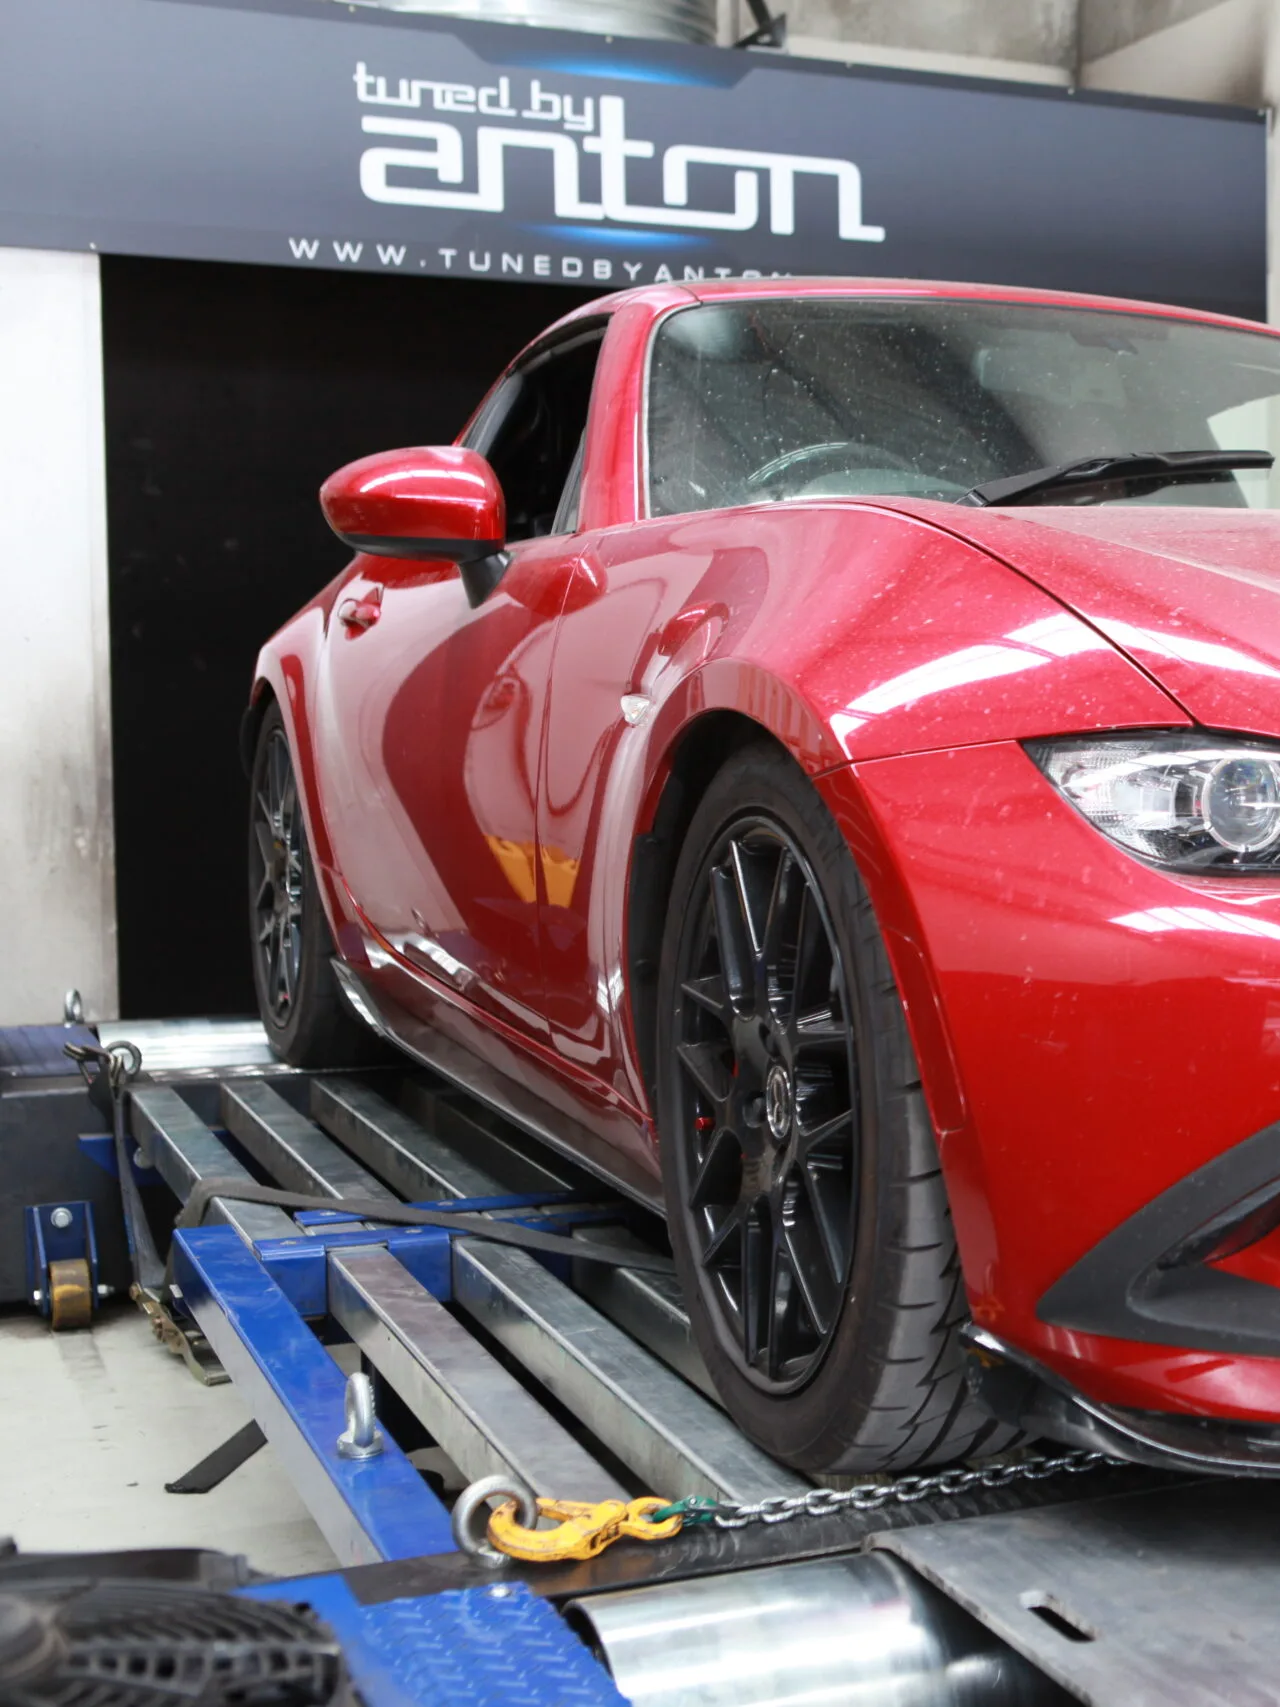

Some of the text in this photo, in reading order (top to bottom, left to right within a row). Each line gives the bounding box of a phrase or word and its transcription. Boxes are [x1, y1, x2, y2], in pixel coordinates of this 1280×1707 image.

[352, 60, 596, 133] tuned by
[359, 94, 887, 243] anton
